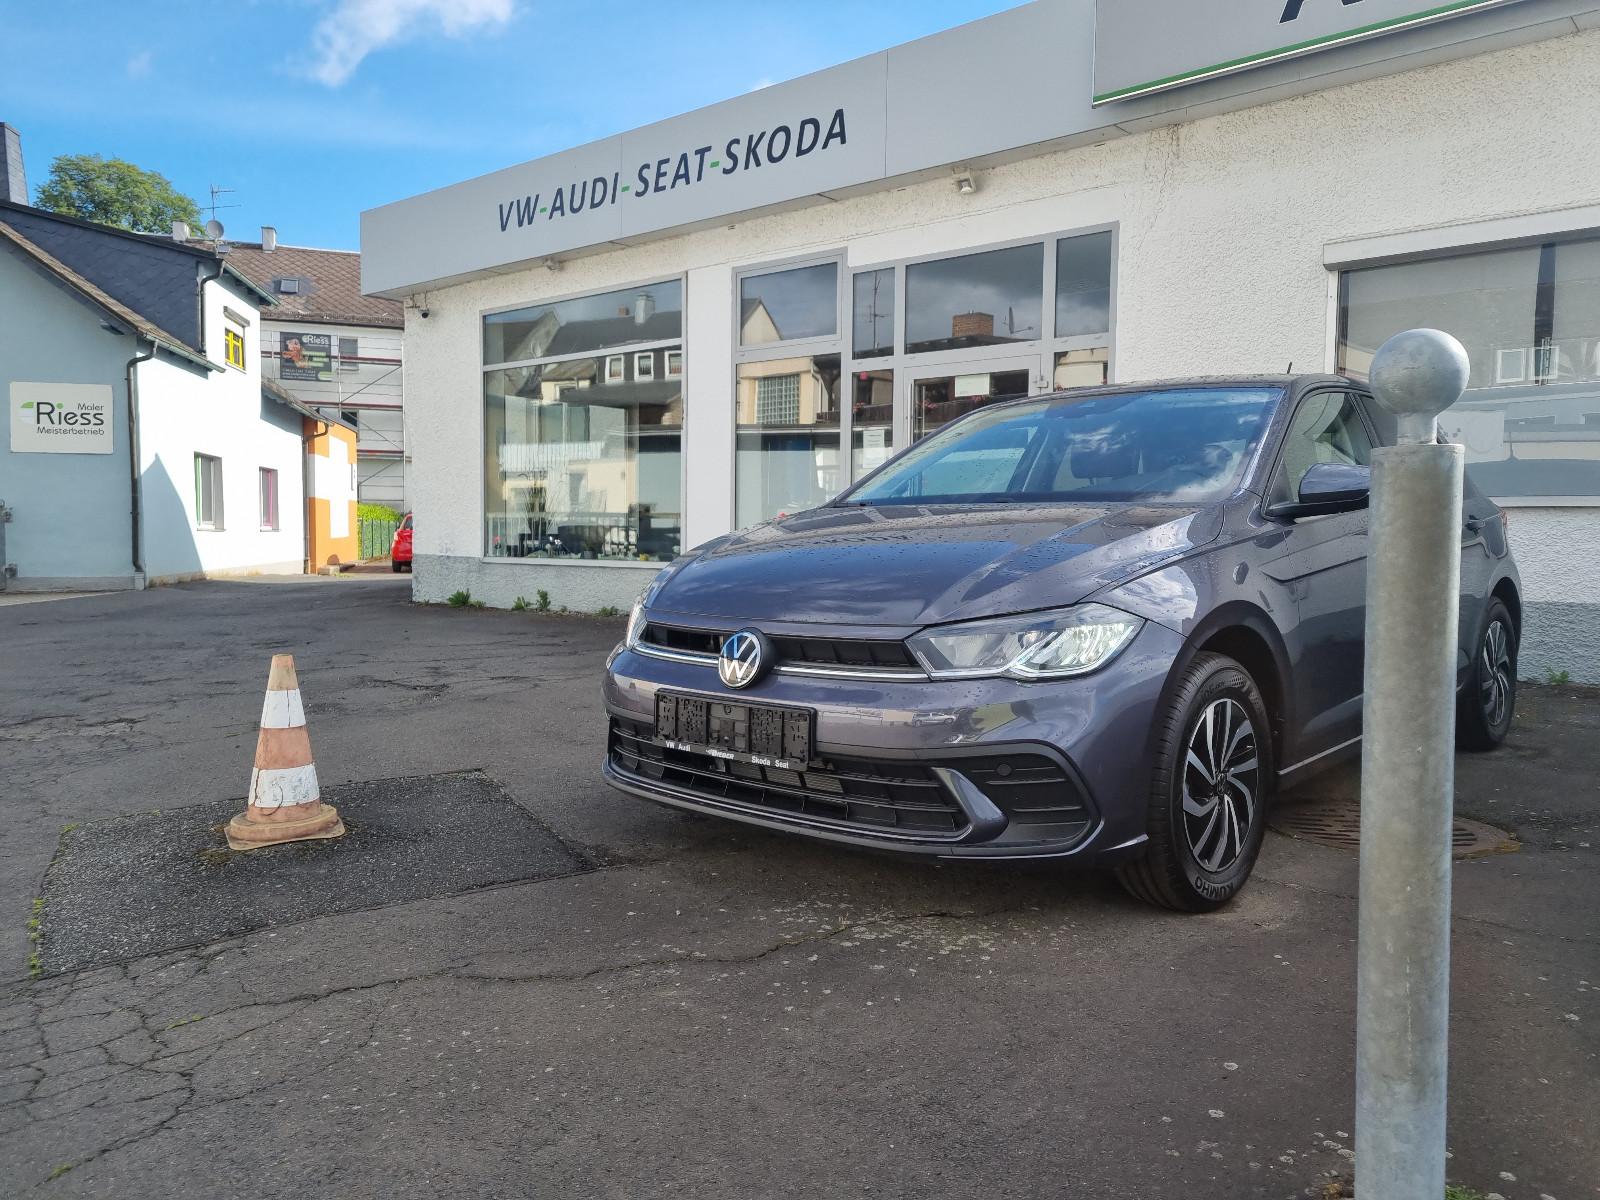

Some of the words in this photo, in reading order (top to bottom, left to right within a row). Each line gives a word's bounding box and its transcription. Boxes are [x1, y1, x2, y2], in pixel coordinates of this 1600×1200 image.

[499, 108, 847, 232] VW-AUDI-SEAT-SKODA
[36, 402, 105, 426] Riess
[77, 403, 105, 411] Maler
[37, 427, 105, 436] Meisterbetrieb
[665, 740, 675, 749] VW
[678, 743, 691, 752] Audi
[751, 755, 771, 766] Skoda
[775, 759, 789, 769] Seat
[1195, 876, 1234, 898] KUMHO
